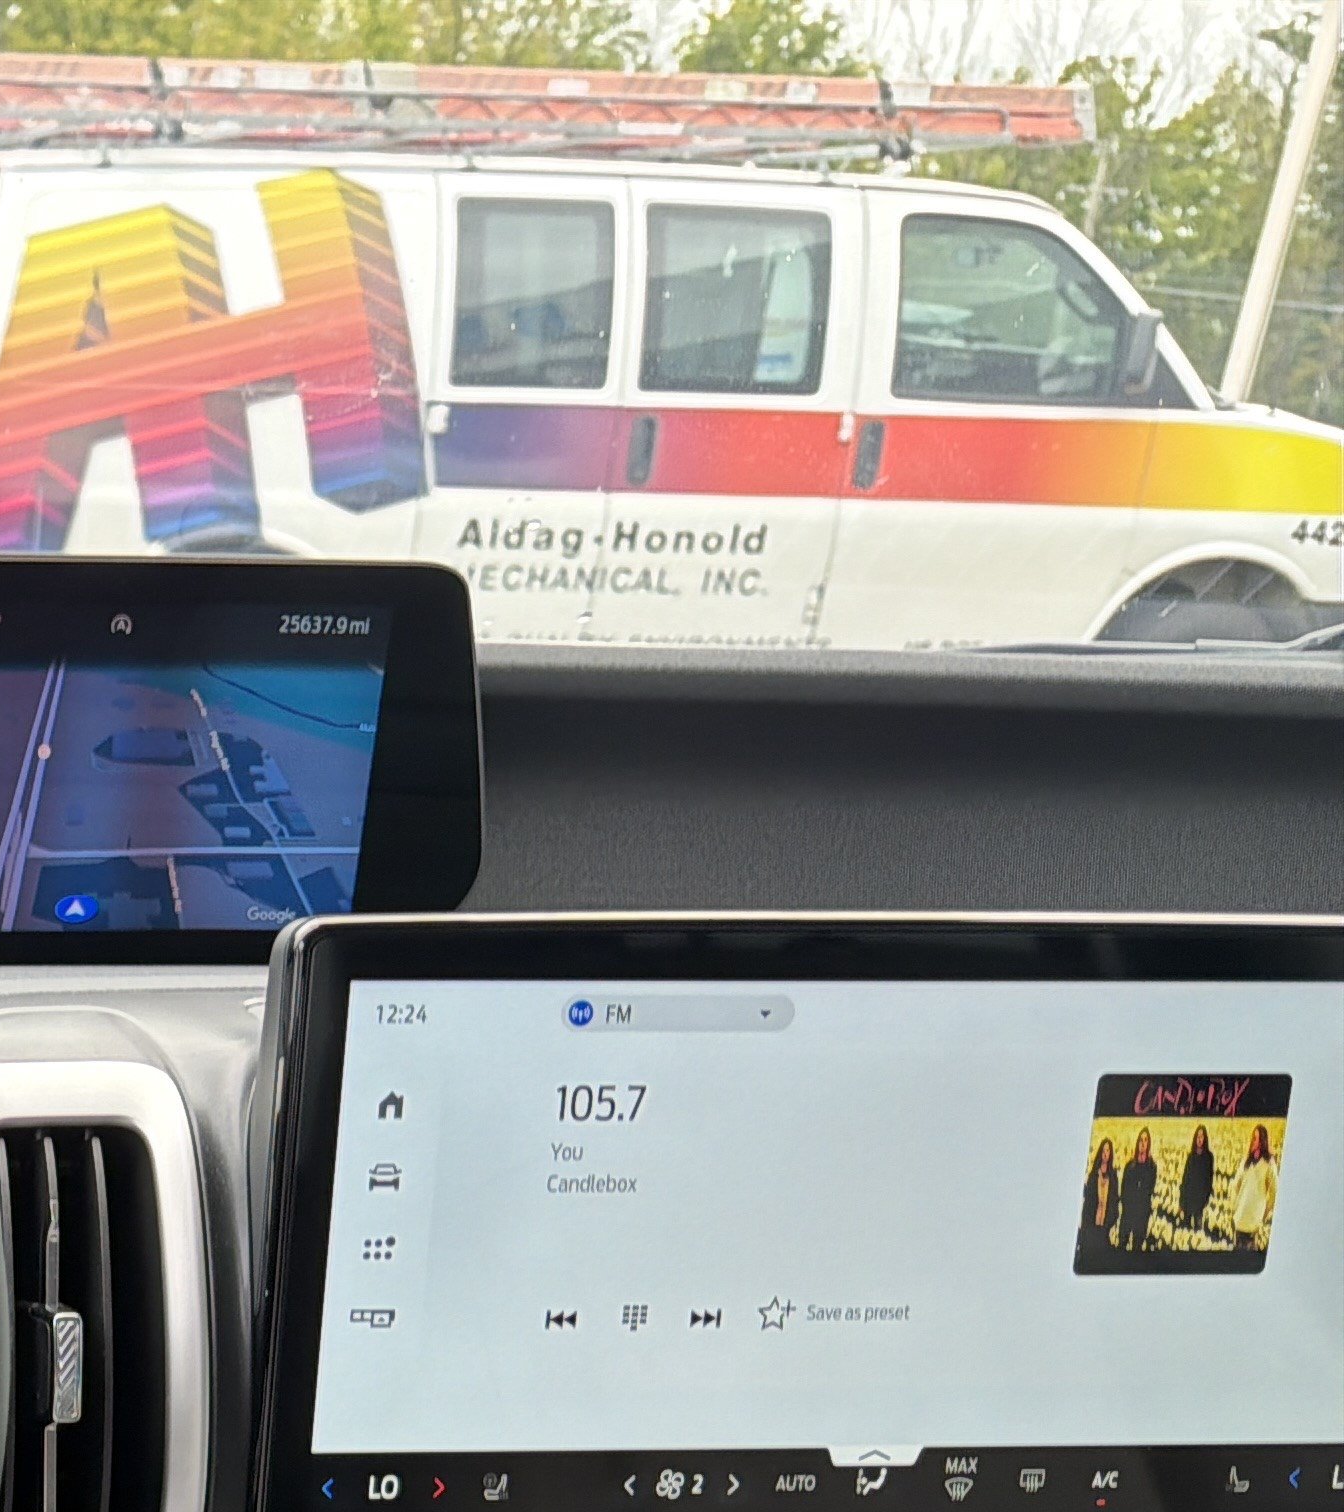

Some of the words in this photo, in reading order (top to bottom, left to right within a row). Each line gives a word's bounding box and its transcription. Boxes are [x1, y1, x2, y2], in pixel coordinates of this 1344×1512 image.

[246, 906, 297, 925] Google
[375, 1004, 428, 1025] 12:24
[605, 1005, 633, 1025] FM
[557, 1084, 648, 1122] 105.7
[551, 1142, 585, 1162] You
[546, 1174, 638, 1194] Candlebox
[806, 1303, 842, 1321] Save
[844, 1307, 862, 1321] as
[863, 1304, 911, 1324] preset
[944, 1456, 979, 1474] MAX
[368, 1474, 400, 1500] LO
[691, 1474, 705, 1495] 2
[775, 1473, 817, 1492] AUTO
[1091, 1470, 1119, 1489] A/C
